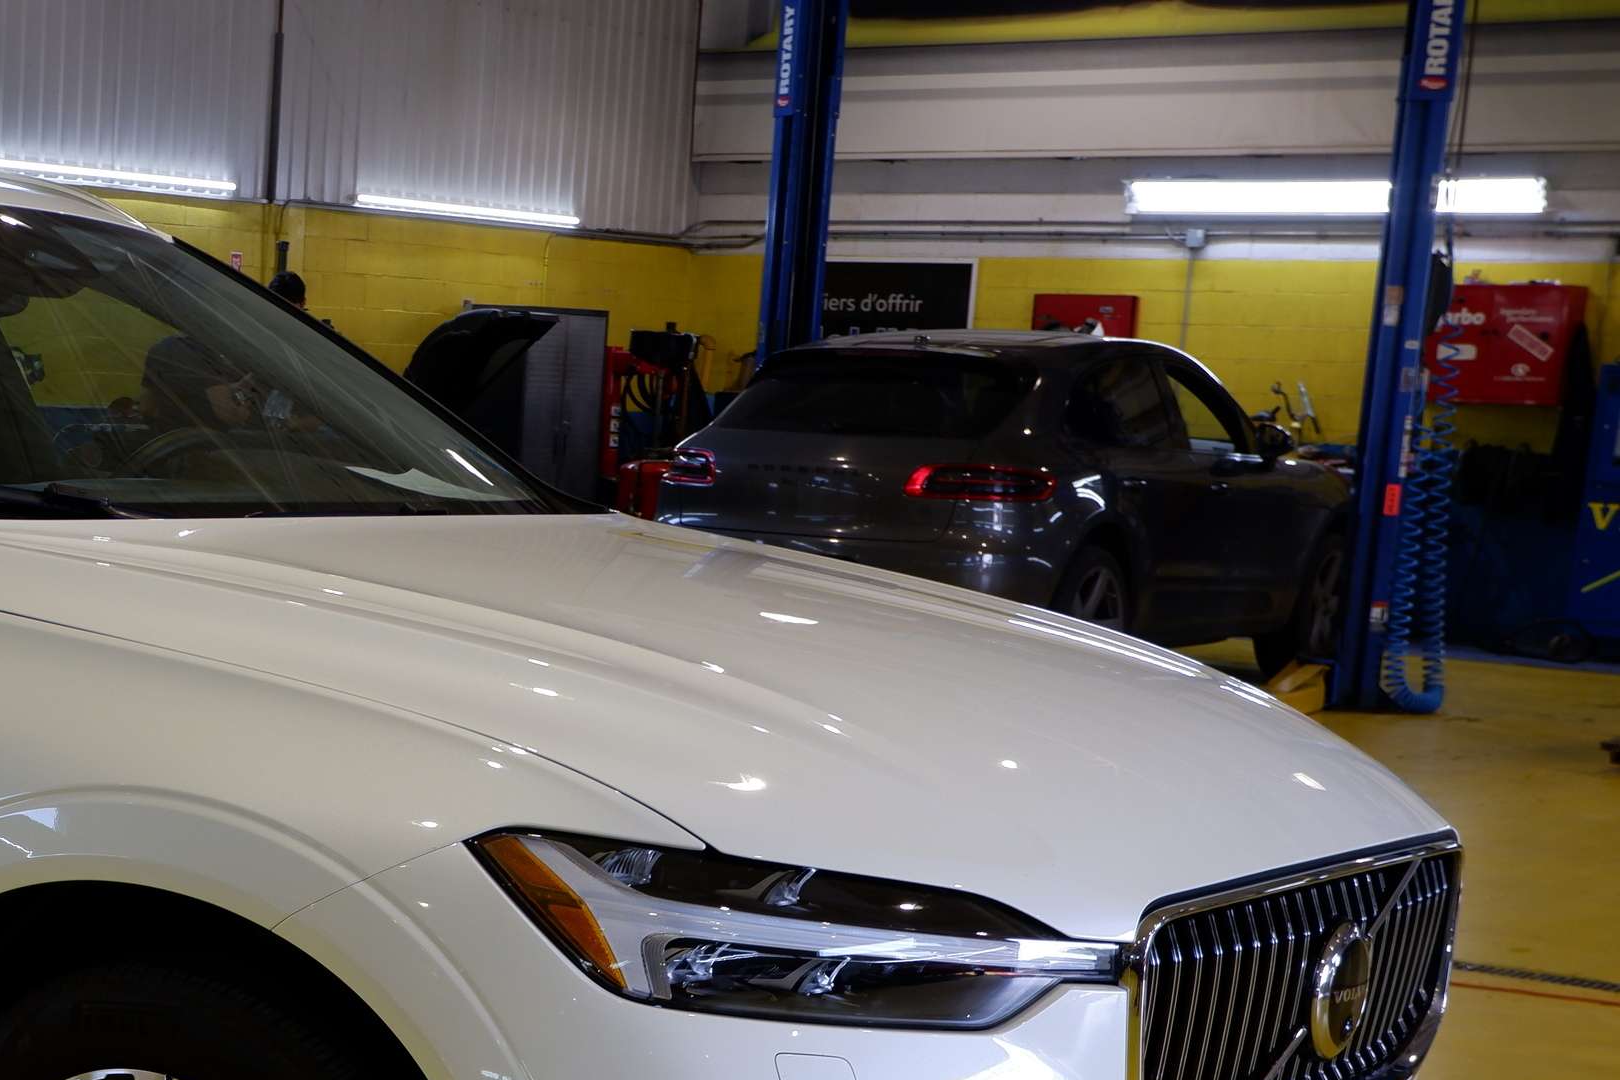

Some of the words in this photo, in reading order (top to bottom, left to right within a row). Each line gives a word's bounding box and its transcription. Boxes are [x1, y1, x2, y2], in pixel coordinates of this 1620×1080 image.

[779, 5, 796, 95] ROTARY
[1424, 0, 1455, 75] ROTA
[823, 292, 856, 312] iers
[860, 292, 924, 313] d'offrir
